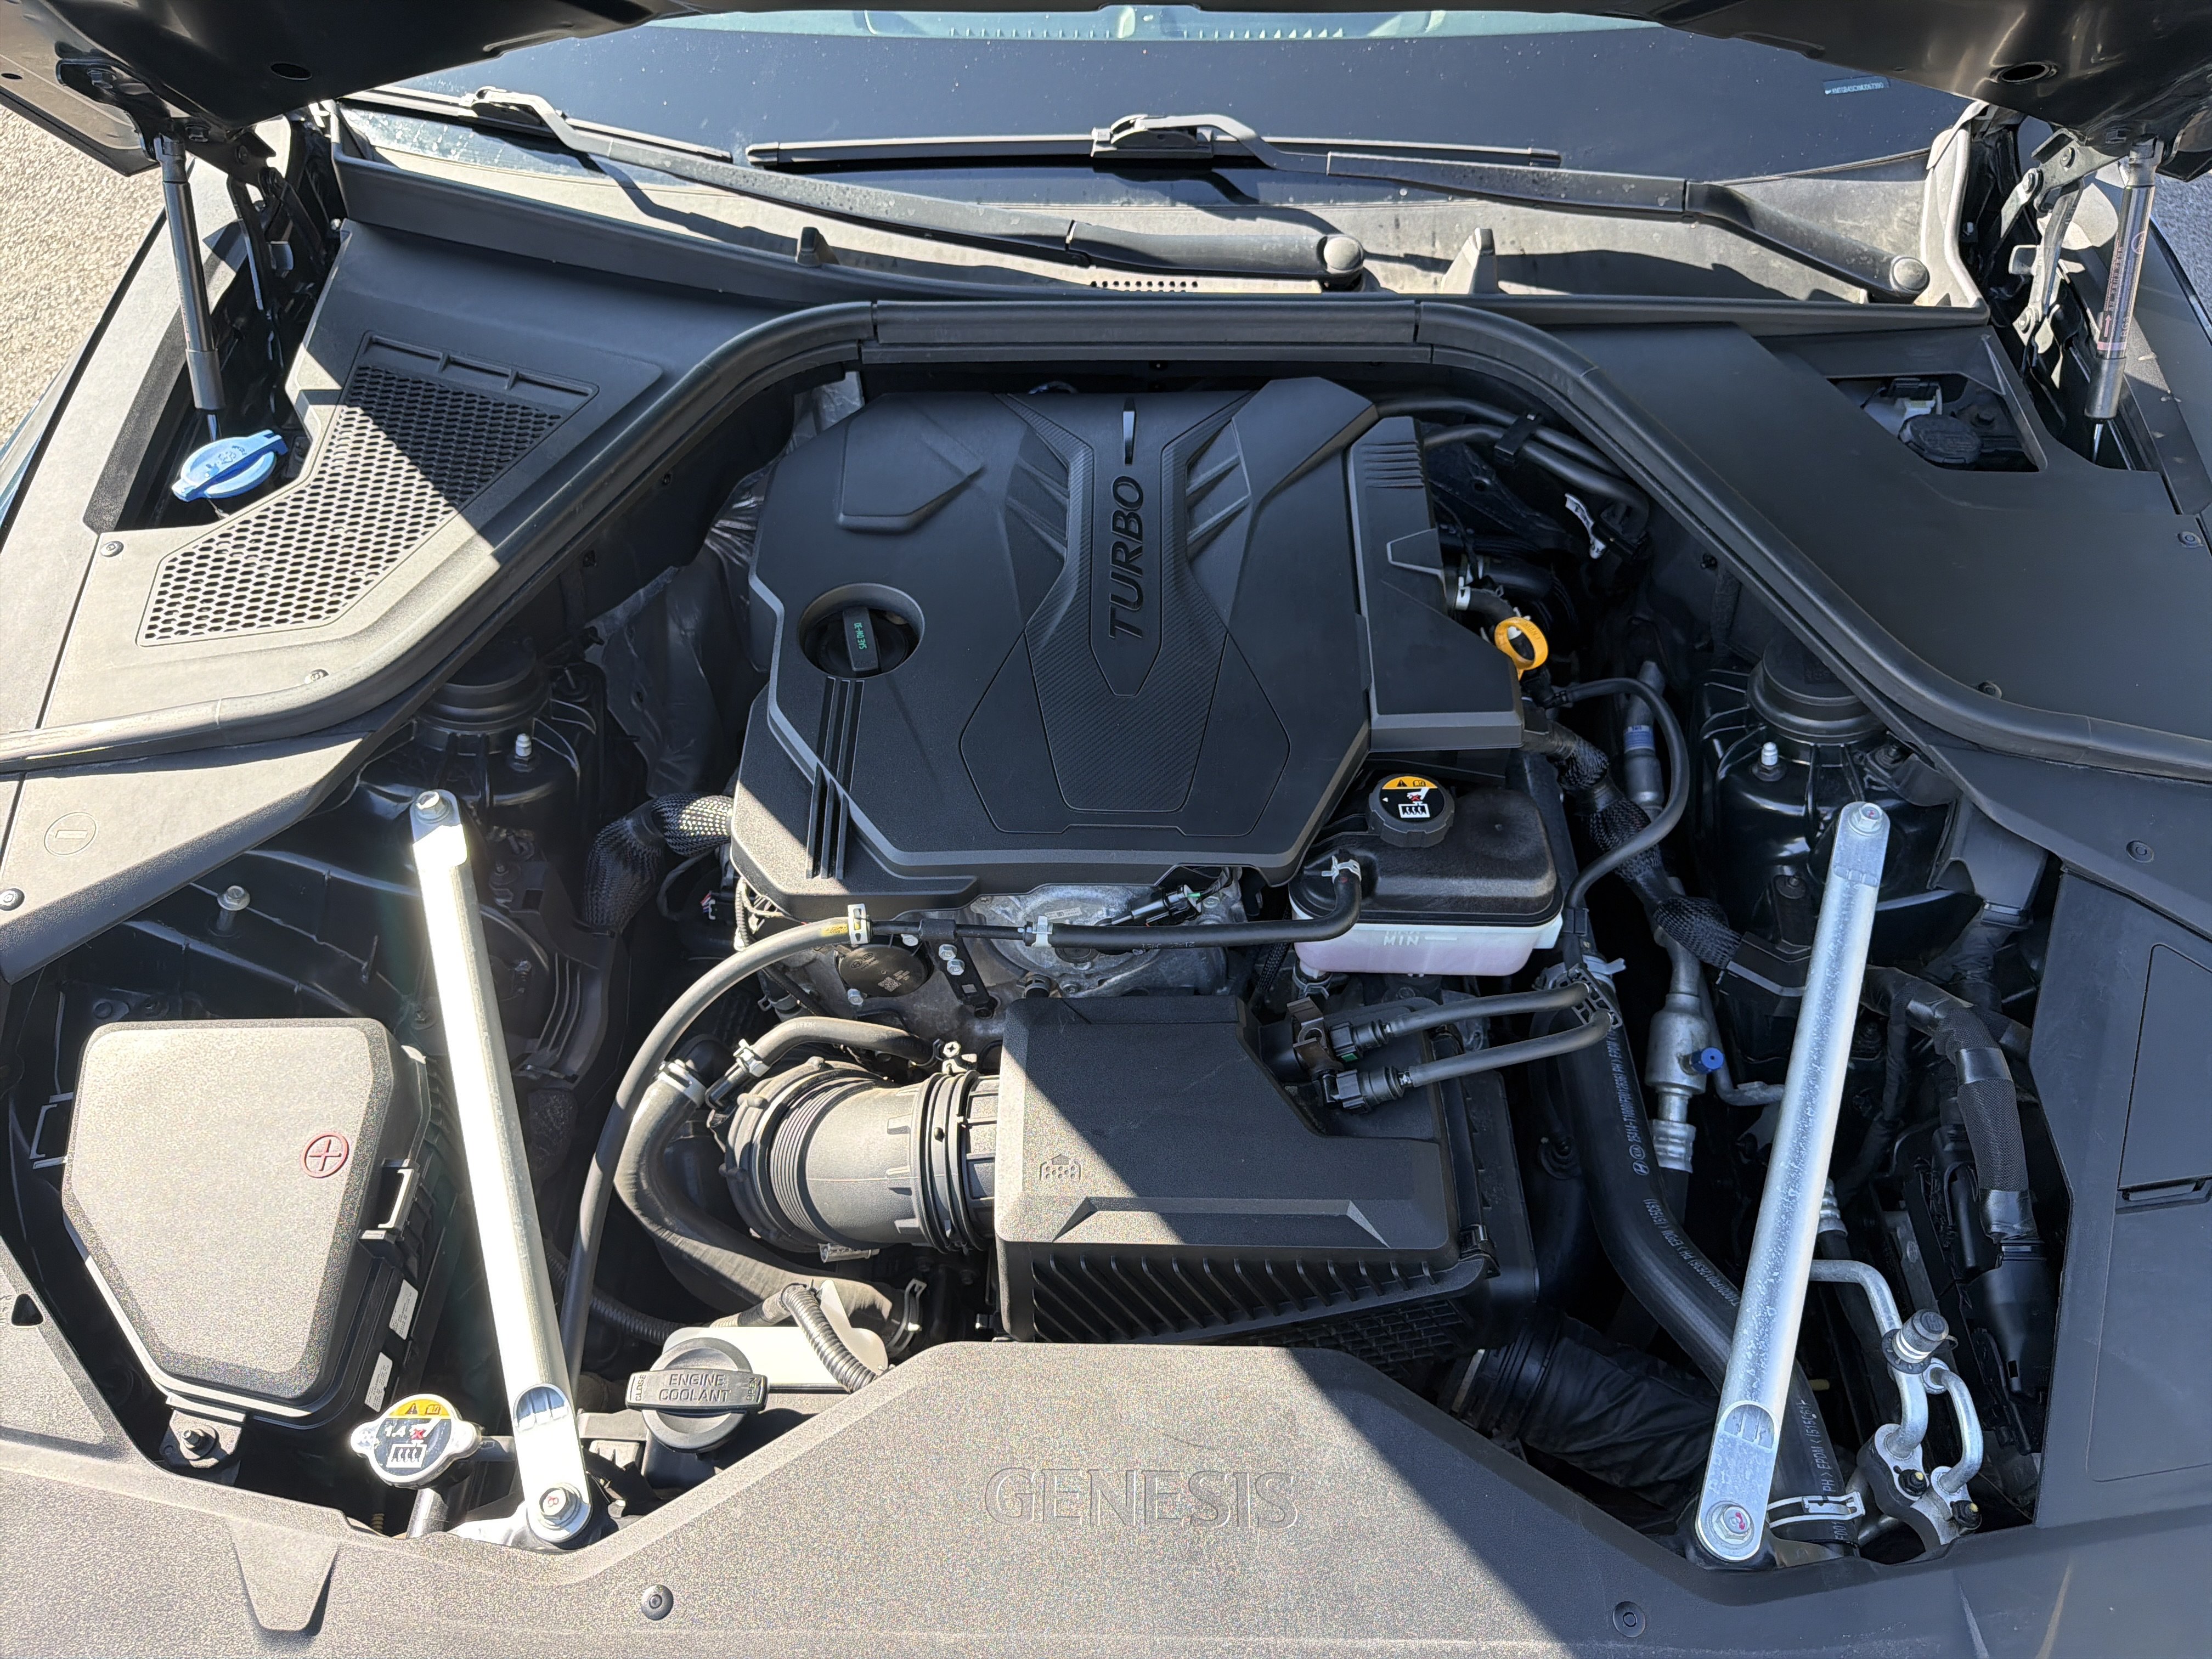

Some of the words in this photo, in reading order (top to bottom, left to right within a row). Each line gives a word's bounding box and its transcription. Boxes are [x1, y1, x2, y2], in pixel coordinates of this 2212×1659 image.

[1109, 476, 1144, 640] TURBO
[857, 639, 867, 650] SAE
[1383, 935, 1420, 946] MIN
[669, 1374, 725, 1386] ENGINE
[635, 1374, 646, 1401] CLOSE
[746, 1378, 758, 1401] OPEN
[658, 1389, 732, 1402] COOLANT
[385, 1425, 406, 1437] 1.4
[985, 1468, 1299, 1528] GENESIS
